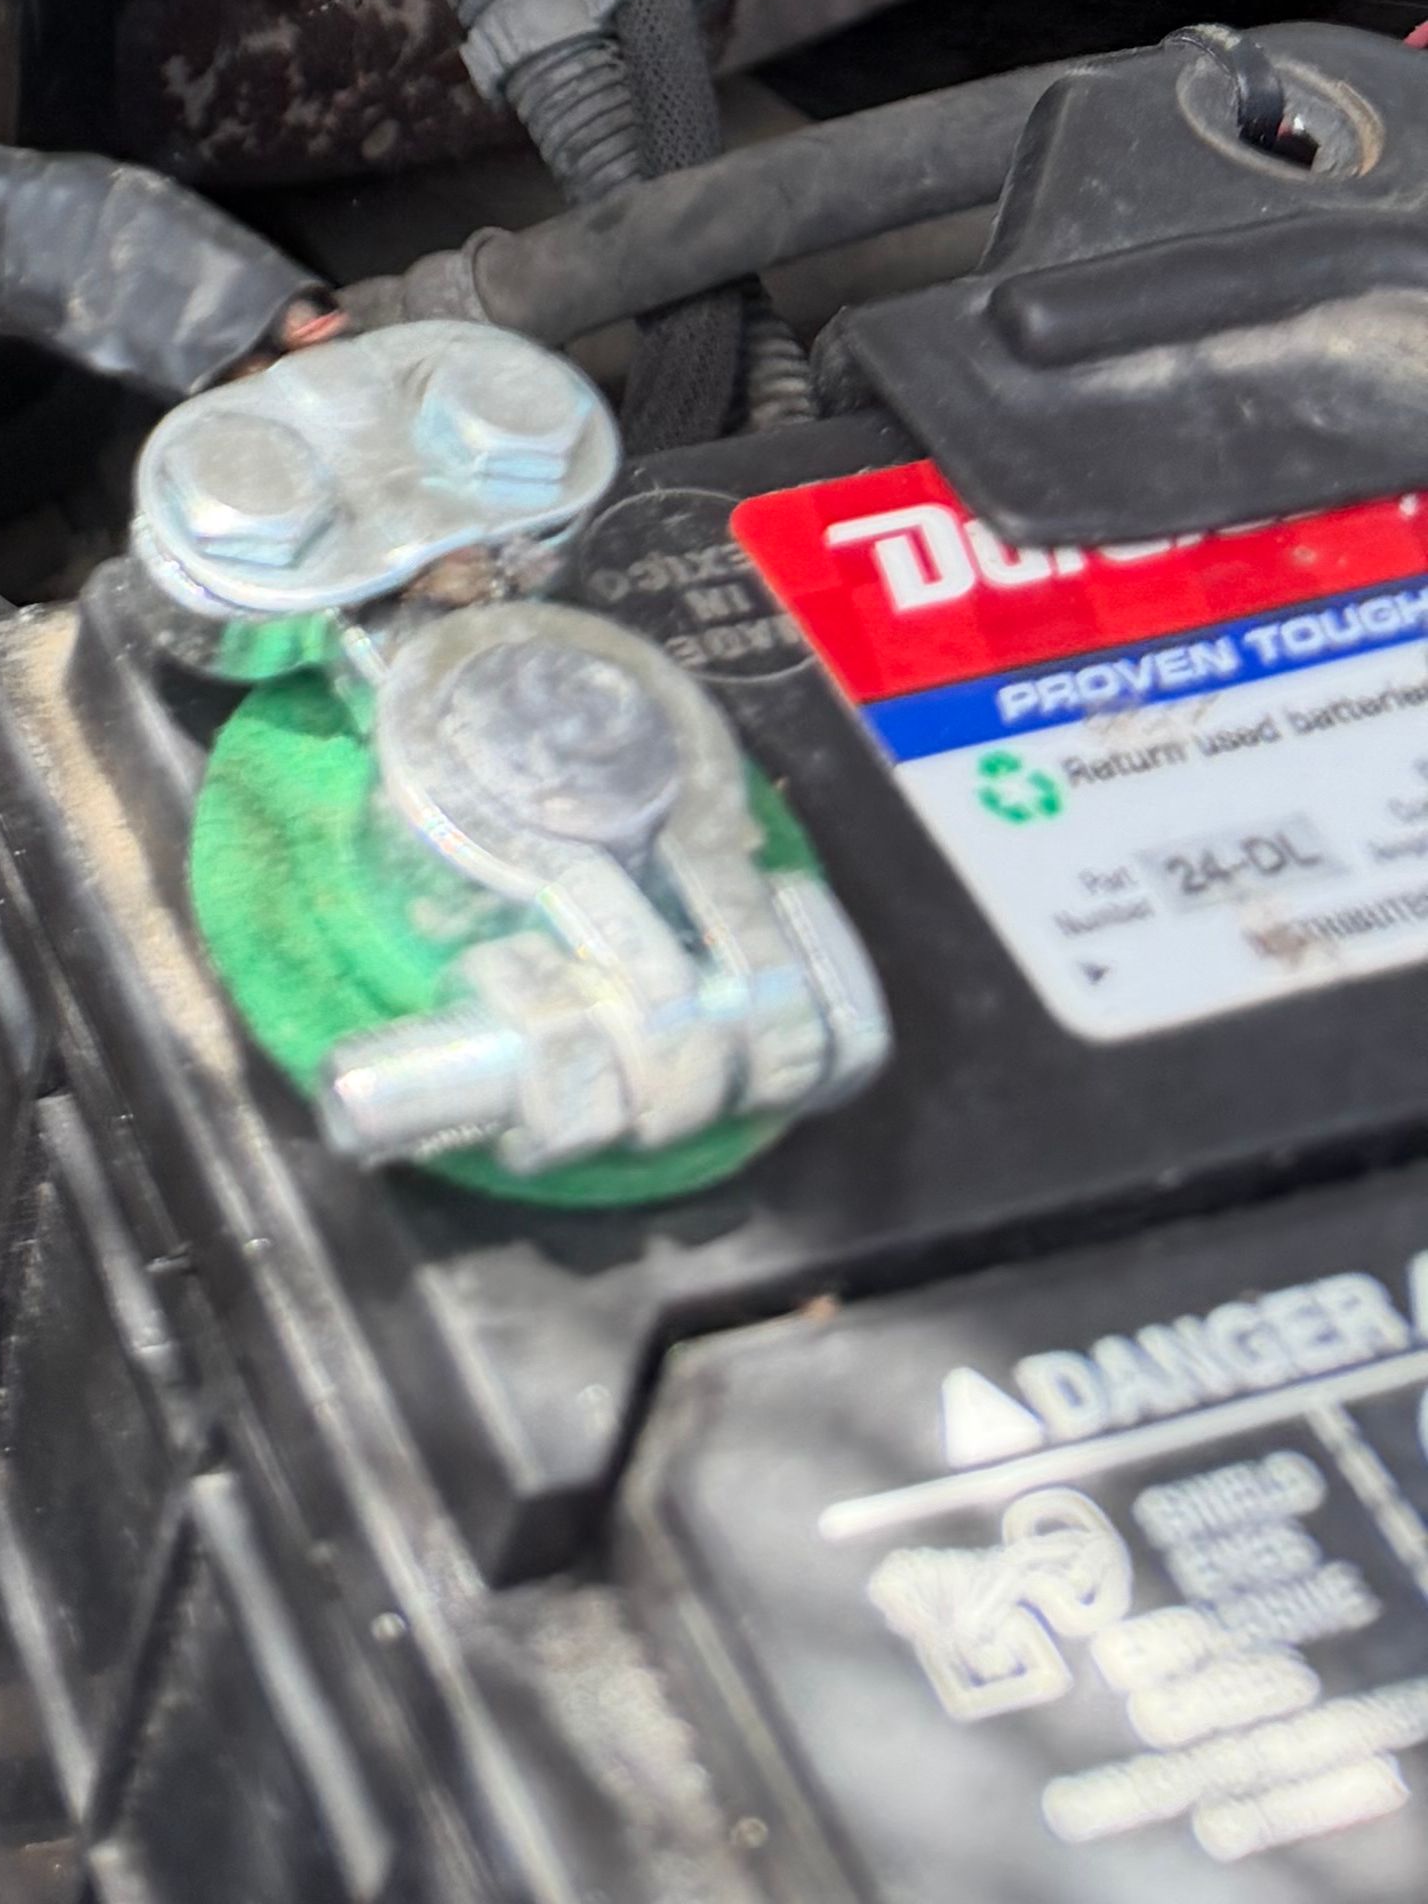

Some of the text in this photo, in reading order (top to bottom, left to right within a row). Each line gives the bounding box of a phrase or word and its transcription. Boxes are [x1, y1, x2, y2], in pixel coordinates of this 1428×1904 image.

[587, 540, 756, 602] EXICO
[997, 637, 1243, 725] PROVEN
[1060, 682, 1428, 789] Return used batterie
[1163, 831, 1324, 897] 24-DL
[1013, 1270, 1413, 1446] DANGER
